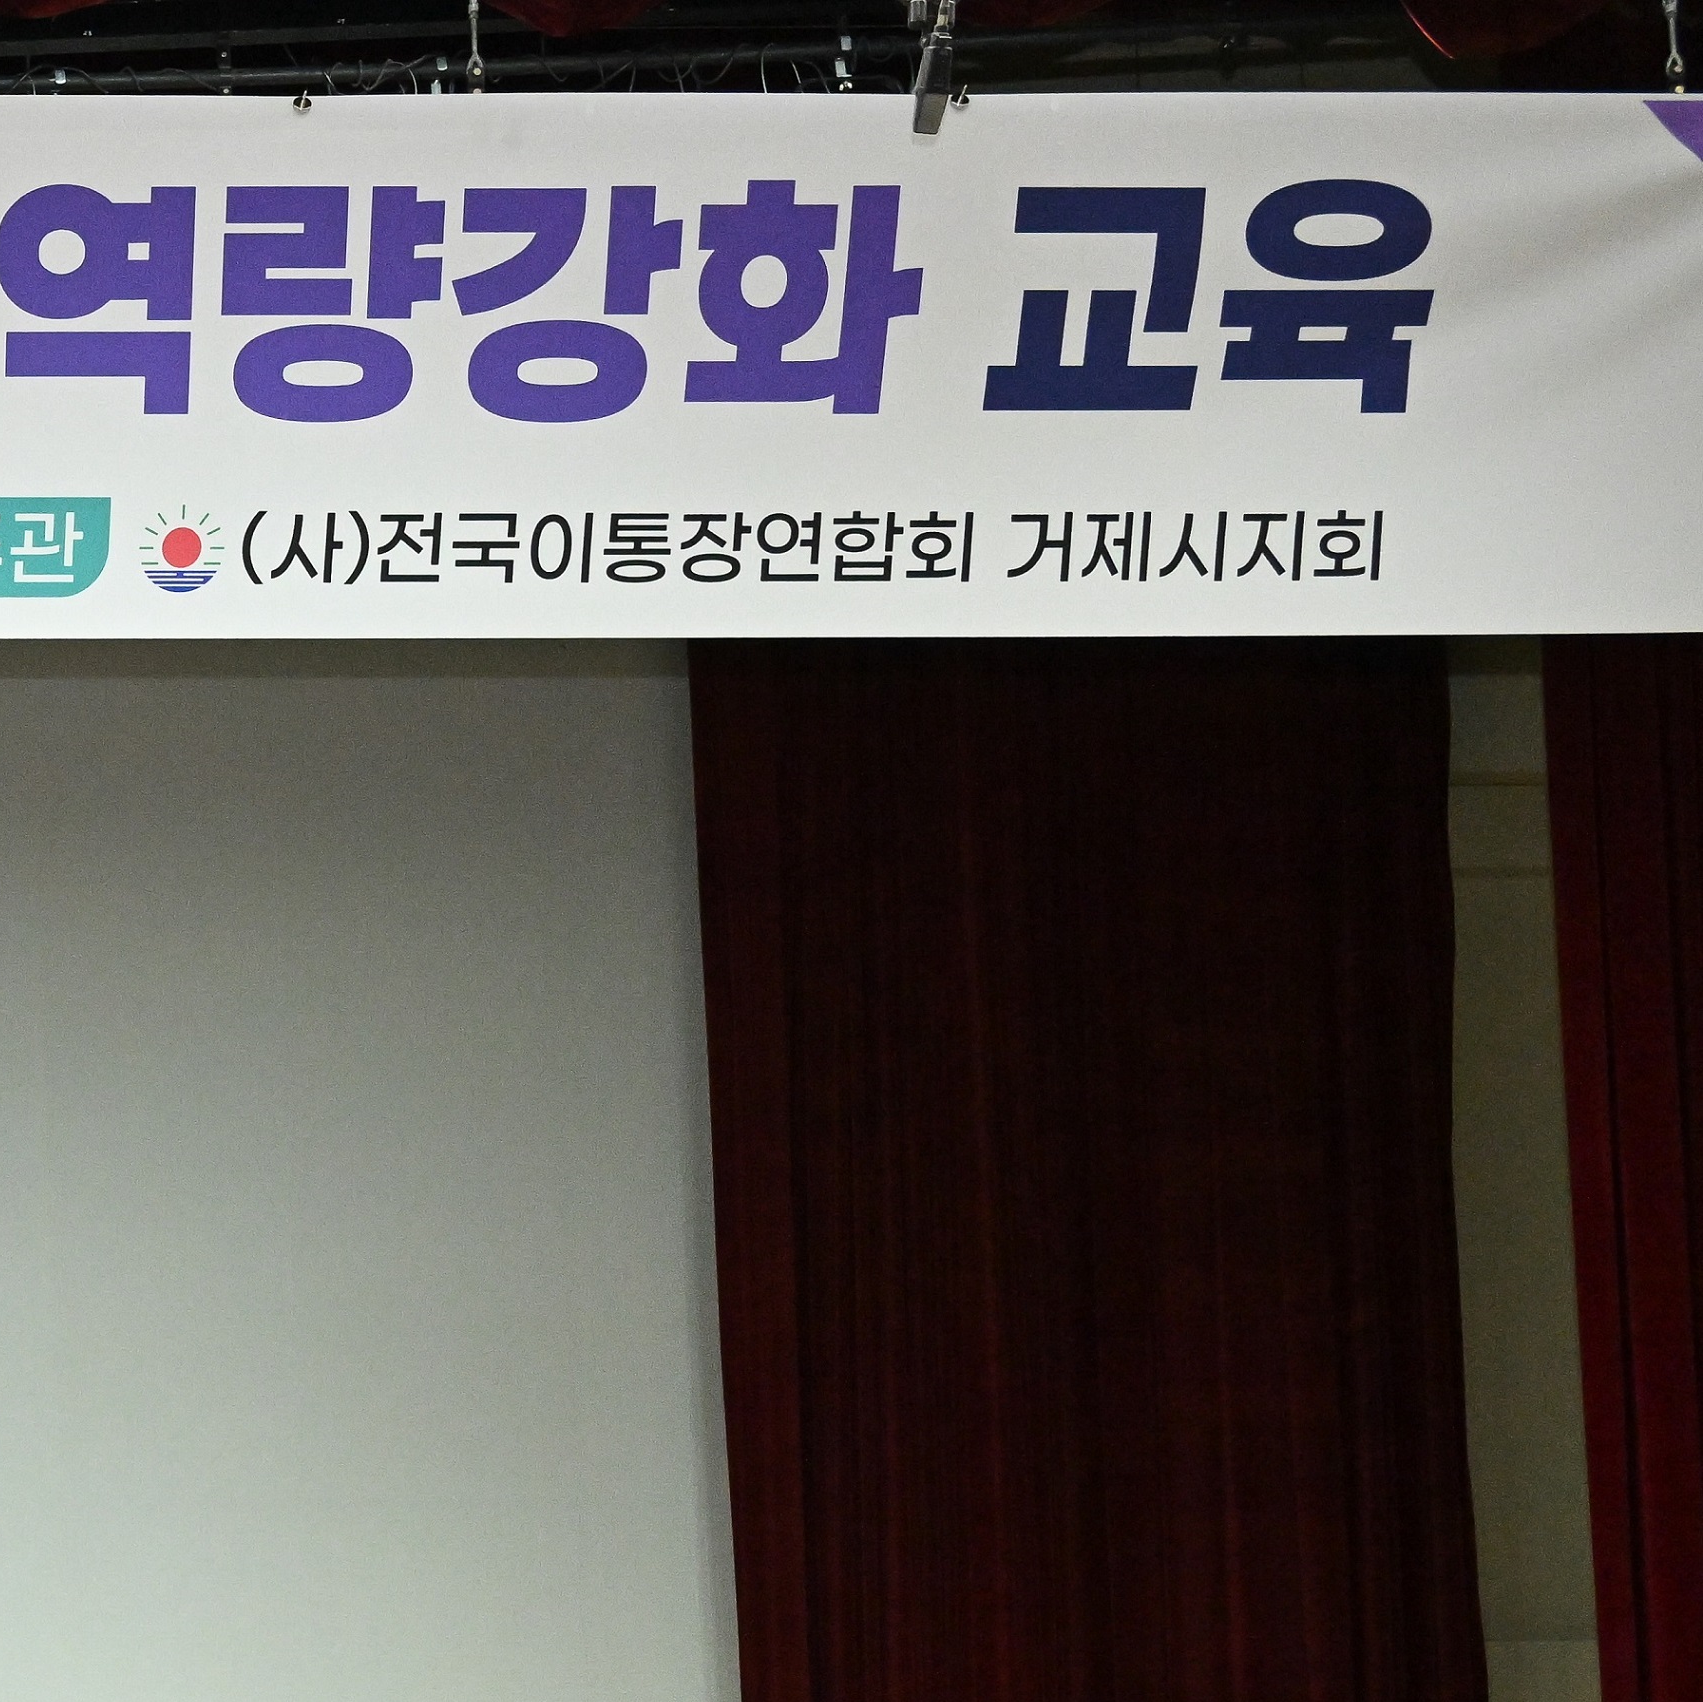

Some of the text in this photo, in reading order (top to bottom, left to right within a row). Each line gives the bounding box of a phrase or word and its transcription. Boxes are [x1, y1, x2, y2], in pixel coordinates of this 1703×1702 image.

[981, 177, 1436, 414] 교육
[240, 508, 1384, 585] (사)전국이통장연합회 거제시지회
